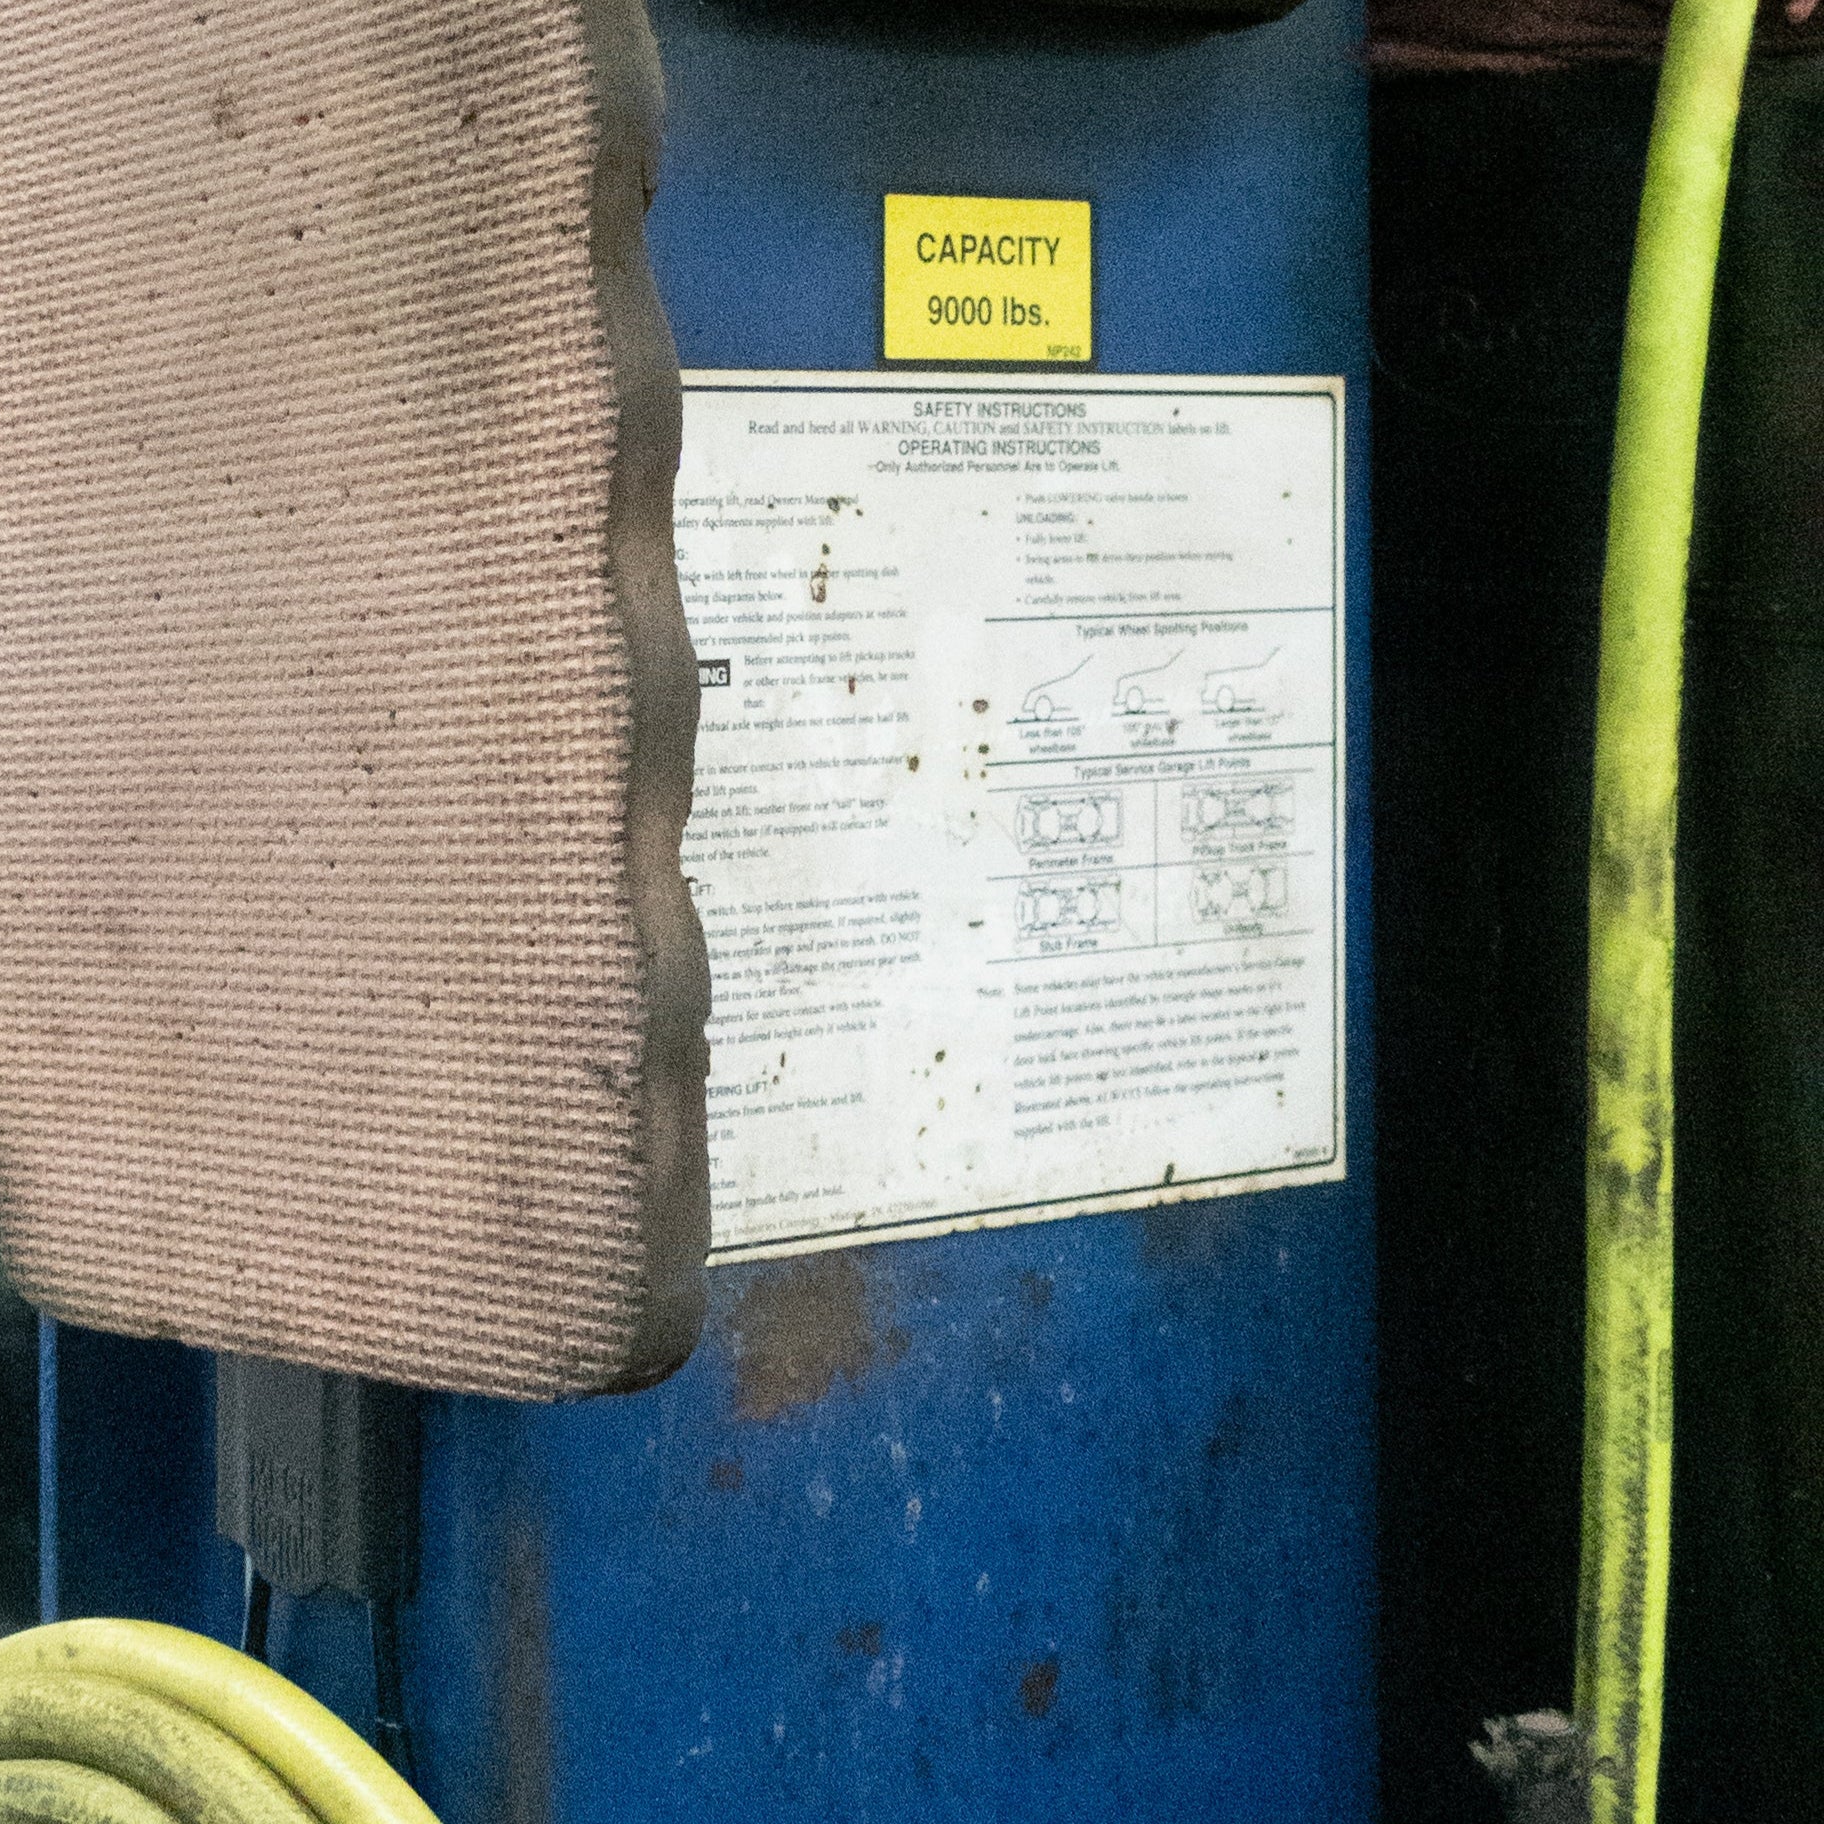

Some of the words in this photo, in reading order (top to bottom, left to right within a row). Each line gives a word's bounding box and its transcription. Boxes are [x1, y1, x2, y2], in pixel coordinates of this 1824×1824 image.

[916, 232, 1060, 266] CAPACITY
[928, 295, 992, 326] 9000
[1002, 296, 1050, 327] lbs.
[913, 401, 973, 417] SAFETY
[977, 402, 1087, 418] INSTRUCTIONS
[748, 420, 779, 434] Read
[782, 420, 805, 434] and
[809, 420, 837, 434] heed
[840, 420, 855, 434] all
[933, 421, 995, 435] CAUTION
[999, 422, 1020, 435] and
[1023, 421, 1071, 435] SAFETY
[1078, 422, 1164, 435] INSTRUCTION
[897, 440, 987, 456] OPERATING
[992, 440, 1101, 456] INSTRUCTIONS
[904, 460, 964, 473] Authorized
[968, 460, 1019, 473] Personnel
[1023, 461, 1042, 473] Are
[1058, 460, 1098, 475] Operate
[678, 494, 724, 508] operating
[728, 568, 742, 580] left
[745, 568, 768, 579] front
[703, 611, 729, 623] under
[767, 610, 784, 621] and
[1076, 624, 1114, 638] Typical
[755, 674, 780, 686] other
